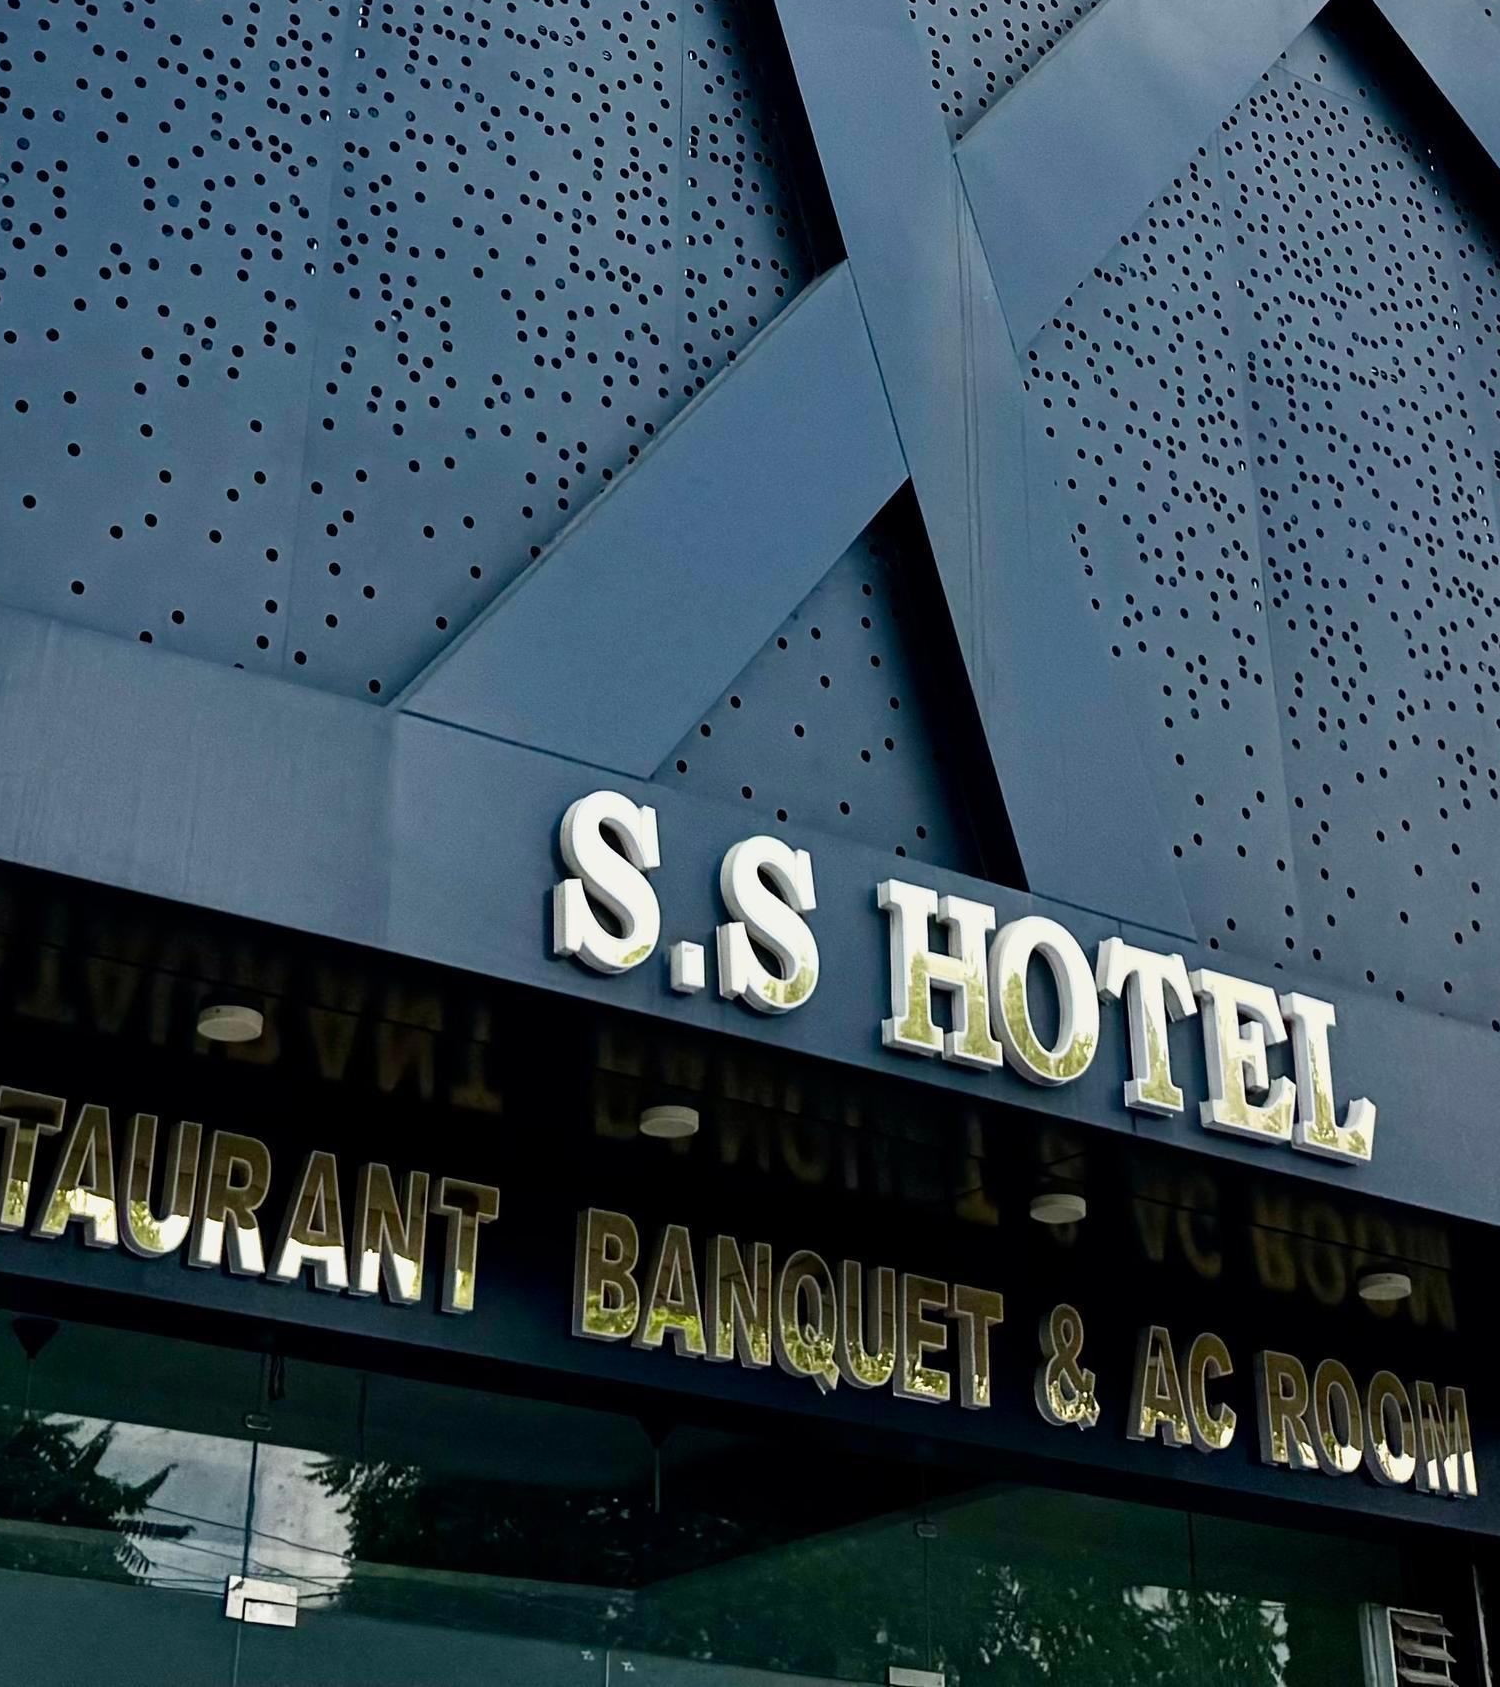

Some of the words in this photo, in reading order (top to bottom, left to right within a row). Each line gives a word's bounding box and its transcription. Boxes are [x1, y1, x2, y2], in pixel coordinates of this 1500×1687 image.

[553, 790, 820, 1014] S.S
[877, 878, 1377, 1167] HOTEL
[572, 1207, 1004, 1410] BANQUET
[1034, 1303, 1100, 1432] &
[1127, 1324, 1237, 1453] AC
[1255, 1348, 1478, 1499] ROOM
